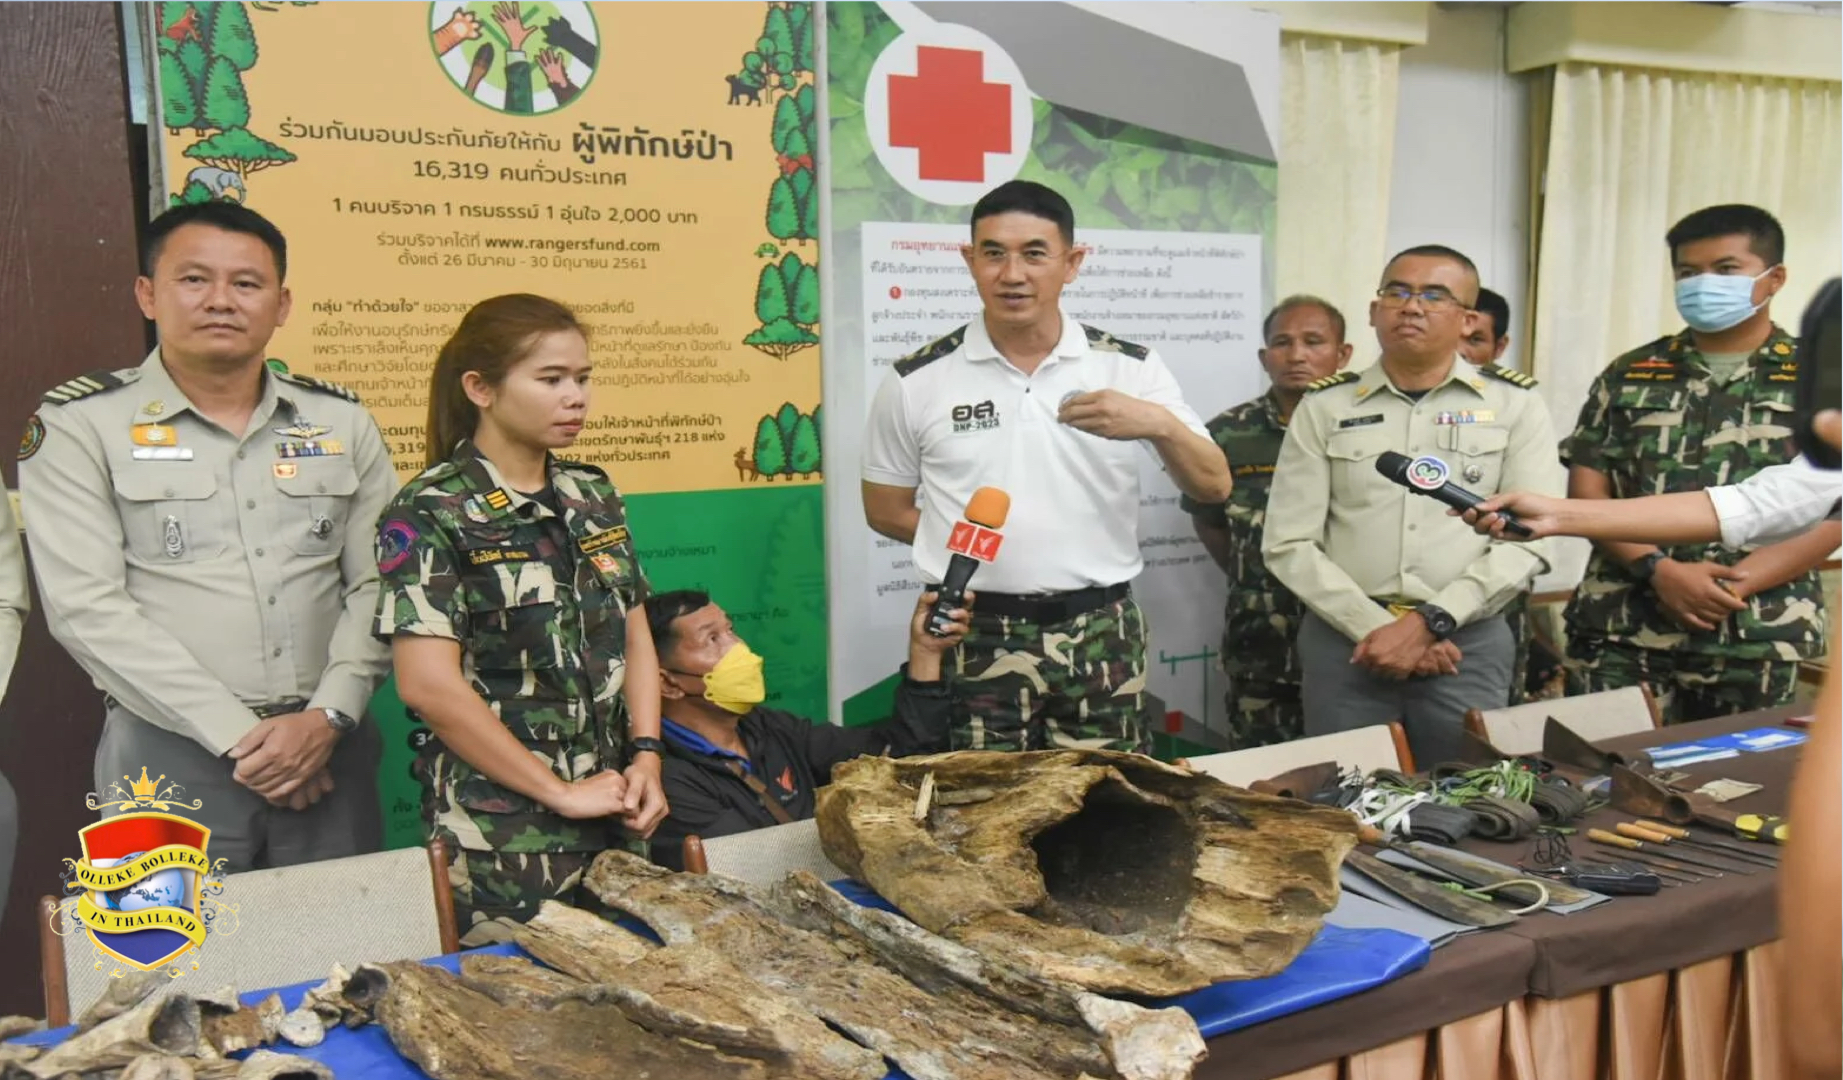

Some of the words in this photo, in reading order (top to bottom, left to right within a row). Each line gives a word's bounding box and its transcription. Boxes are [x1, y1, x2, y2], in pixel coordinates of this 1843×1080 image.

[279, 118, 561, 153] ร่วมกันมอบประกันภัยให้กับ
[572, 121, 734, 164] ผู้พิทักษ์ป่า
[413, 160, 489, 181] 16,319
[500, 160, 628, 187] คนทั่วประเทศ
[333, 199, 342, 213] 1
[350, 199, 436, 217] คนบริจาค
[444, 203, 452, 218] 1
[460, 201, 540, 220] กรมธรรม์
[546, 206, 555, 220] 1
[560, 203, 601, 226] อุ่นใจ
[609, 206, 662, 224] 2,000
[668, 210, 698, 225] บาท
[377, 231, 481, 250] ร่วมบริจาคได้ที่
[485, 235, 661, 254] www.rangersfund.com
[398, 250, 440, 267] ตั้งแต่
[443, 253, 463, 267] 26
[466, 251, 516, 269] มีนาคม
[531, 255, 550, 268] 30
[552, 253, 610, 272] มิถุนายน
[613, 256, 648, 270] 2561
[312, 298, 342, 315] กลุ่ม
[674, 431, 699, 443] 218
[702, 429, 726, 443] แห่ง
[586, 447, 671, 464] แห่งทั่วประเทศ
[416, 732, 427, 746] 3
